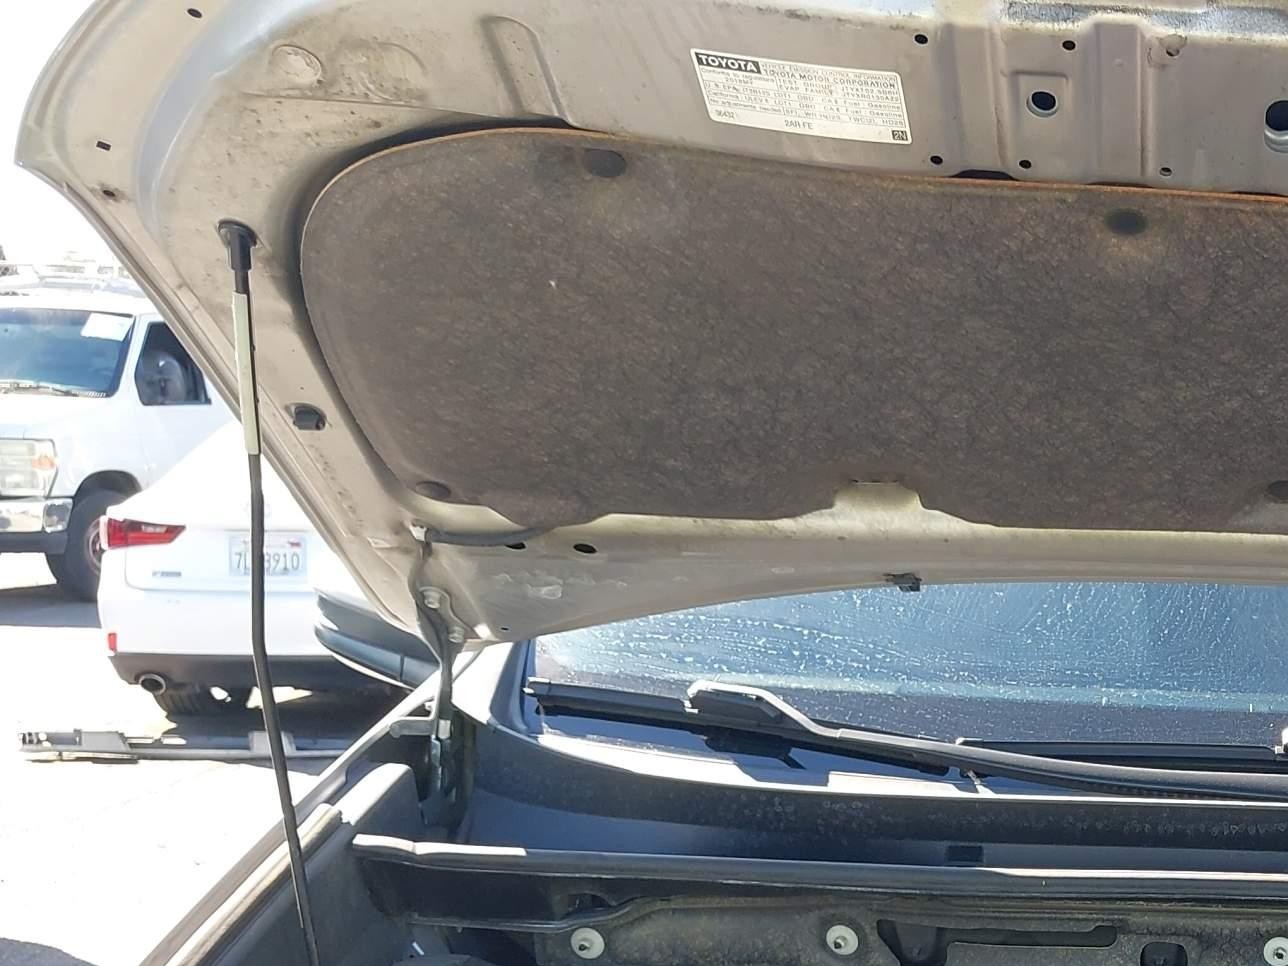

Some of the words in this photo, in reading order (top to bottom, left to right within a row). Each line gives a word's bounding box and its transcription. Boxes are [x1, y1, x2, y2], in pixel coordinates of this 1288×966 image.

[698, 54, 758, 72] TOYOTA
[764, 68, 796, 79] TOYOTA
[799, 73, 830, 83] MOTOR
[834, 77, 896, 89] CORPORATION
[893, 131, 907, 140] 2N
